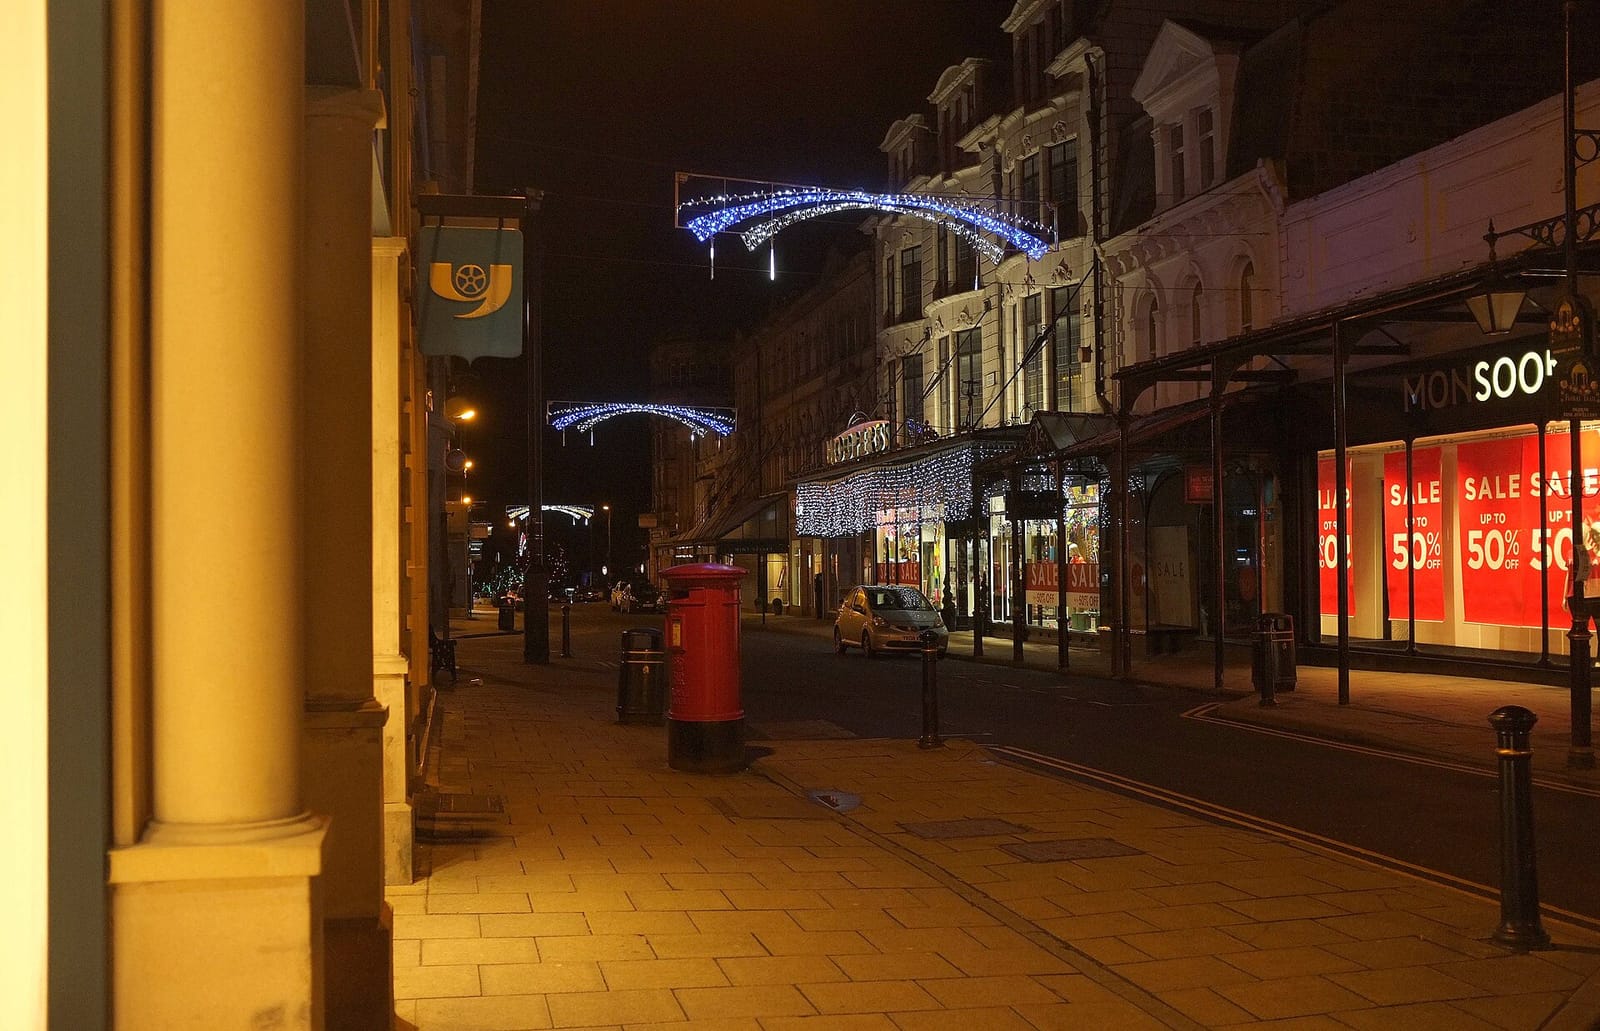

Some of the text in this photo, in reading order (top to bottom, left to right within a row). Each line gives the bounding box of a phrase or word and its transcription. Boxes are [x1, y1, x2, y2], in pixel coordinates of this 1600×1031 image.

[1465, 474, 1521, 501] SALE
[1417, 517, 1428, 527] TO
[1480, 513, 1506, 524] UP TO
[1549, 510, 1573, 522] UP T
[1392, 532, 1441, 570] 50%
[1468, 529, 1520, 570] 50%
[1529, 528, 1573, 571] 50
[901, 564, 918, 581] SALE
[1158, 562, 1185, 577] SALE
[1426, 559, 1441, 569] OFF
[1505, 559, 1519, 569] OFF
[1031, 564, 1058, 586] SALE
[1071, 564, 1100, 588] SALE
